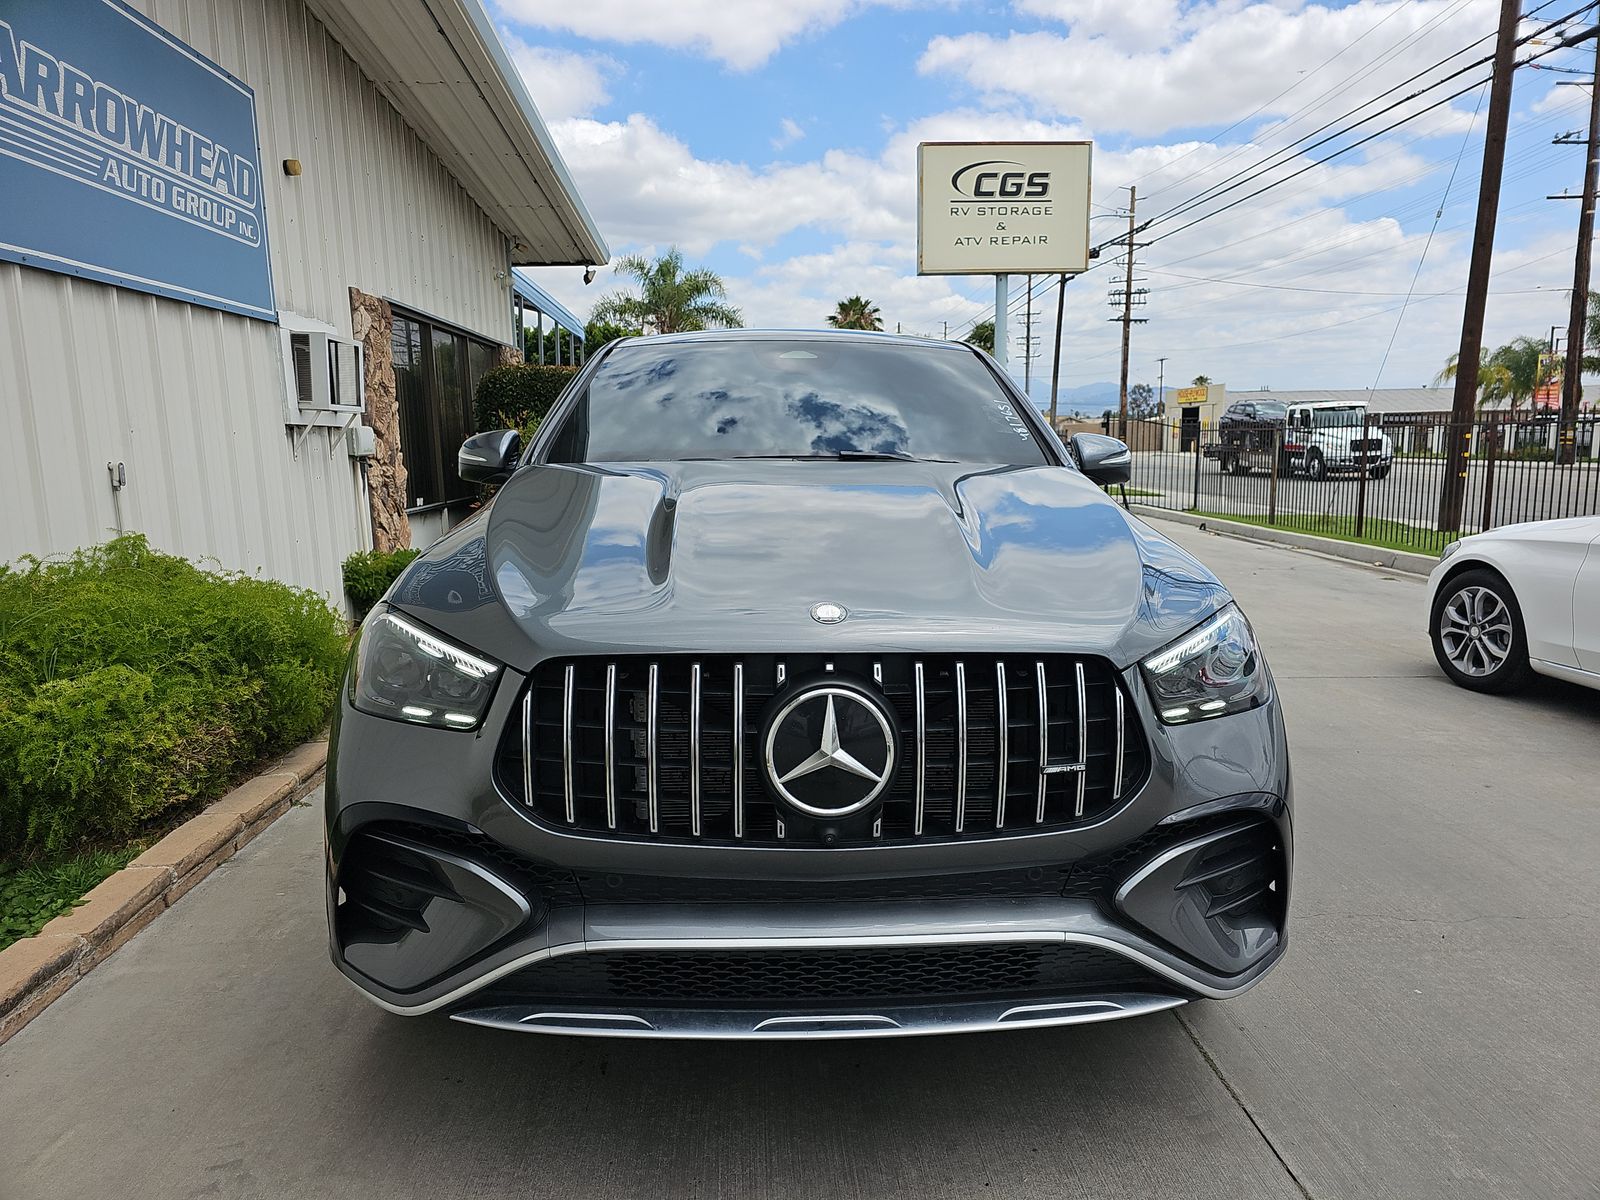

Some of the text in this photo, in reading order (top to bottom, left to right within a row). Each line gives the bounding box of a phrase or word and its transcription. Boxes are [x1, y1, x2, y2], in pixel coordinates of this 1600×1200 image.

[973, 172, 1051, 198] CGS
[103, 158, 257, 240] AUTO GROUP INC.
[950, 206, 1053, 217] RV STORAGE
[996, 221, 1007, 231] &
[954, 235, 1048, 247] ATV REPAIR
